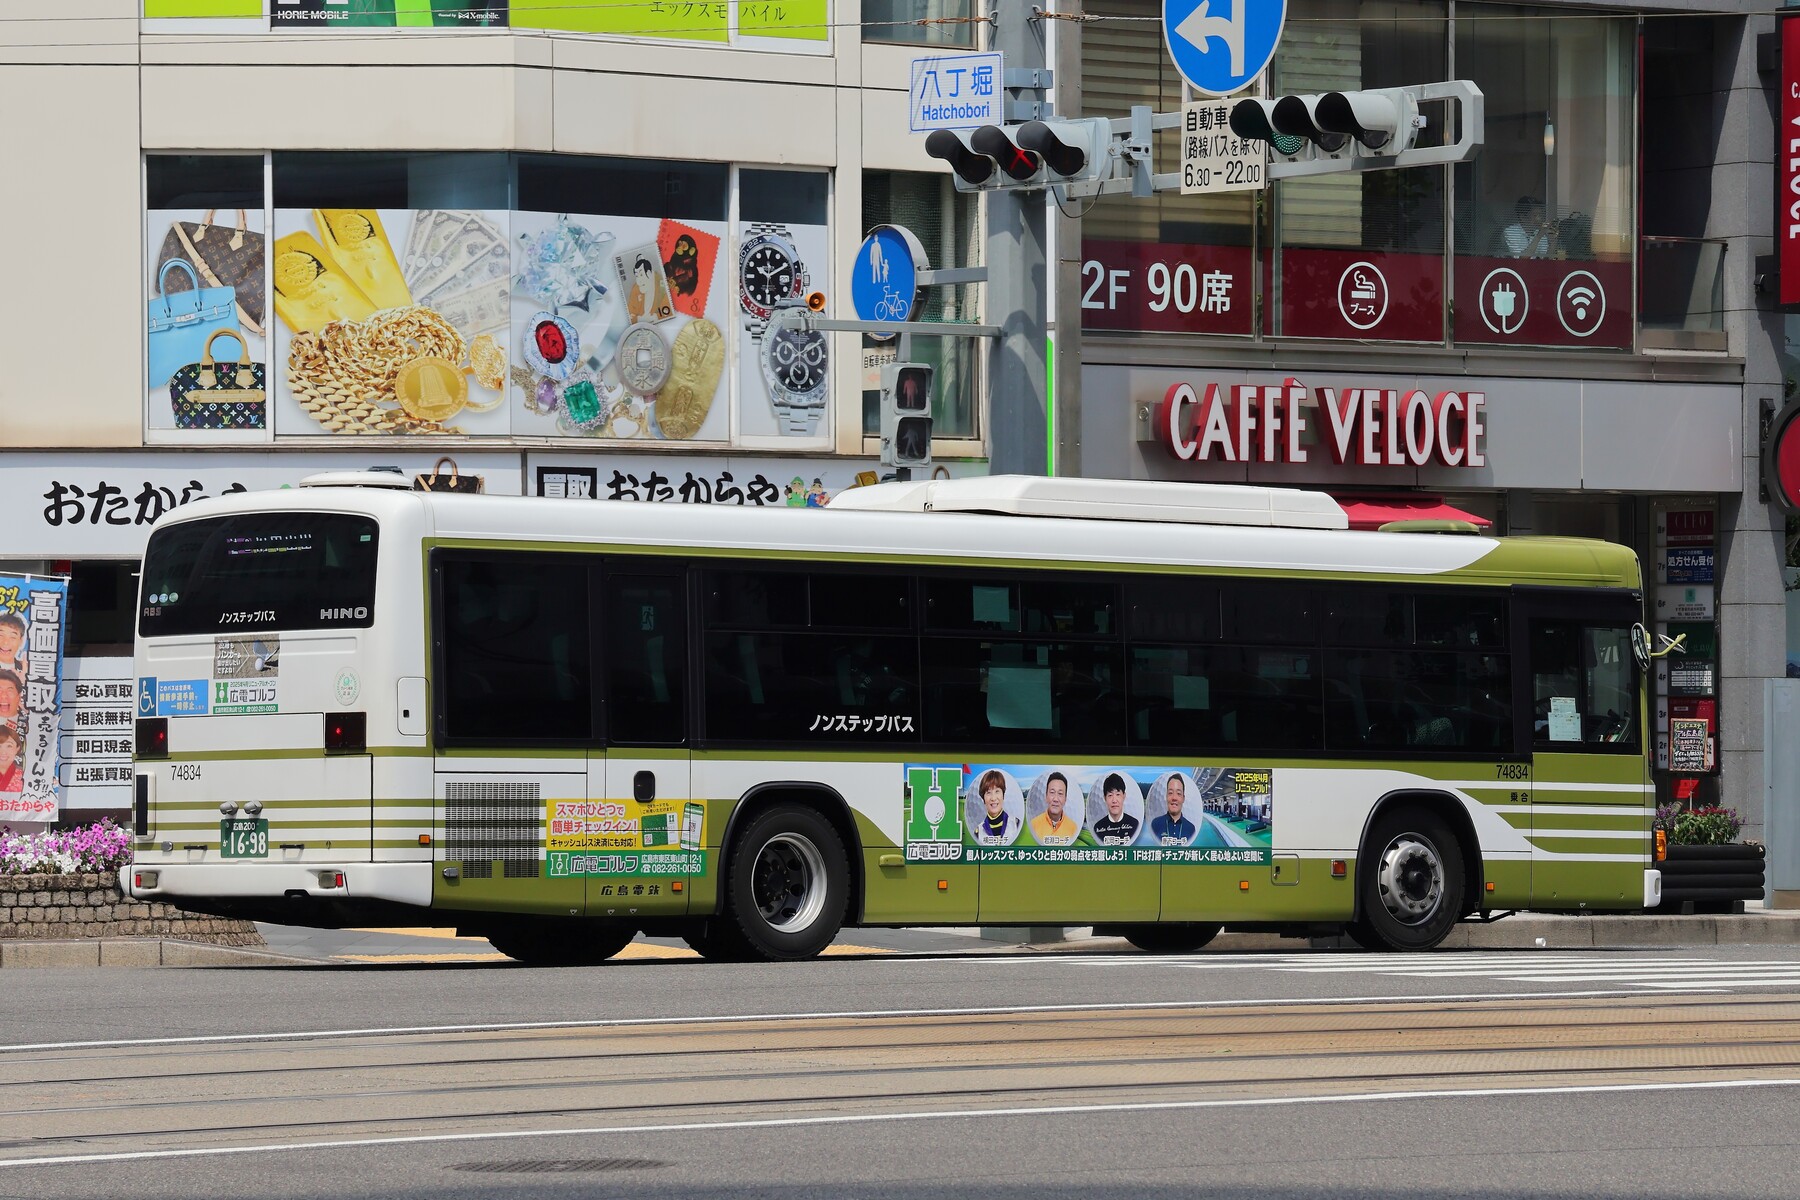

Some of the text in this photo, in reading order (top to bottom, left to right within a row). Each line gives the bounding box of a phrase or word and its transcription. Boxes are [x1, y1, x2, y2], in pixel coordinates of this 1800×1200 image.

[278, 11, 349, 20] HORIE MOBILE
[920, 66, 993, 99] 八丁堀
[922, 101, 990, 120] Hatchobori
[1186, 106, 1236, 132] 自動車
[1081, 260, 1233, 314] 2F 90席
[1350, 303, 1376, 316] ブース
[1315, 387, 1486, 467] VELOCE
[606, 470, 780, 506] おたからや
[1668, 555, 1714, 567] 処方せん受付
[143, 607, 162, 617] ABS
[219, 610, 276, 624] ノンステップバス
[320, 606, 368, 620] HINO
[26, 591, 61, 713] 高価買取
[1658, 673, 1667, 681] 4F
[75, 684, 133, 698] 安心買取
[230, 689, 276, 703] 広電ゴルフ
[75, 712, 132, 726] 相談無料
[809, 714, 915, 732] ノンステップバス
[76, 740, 132, 753] 即日現金
[76, 768, 132, 781] 出張買取
[171, 764, 201, 780] 74834
[1235, 773, 1268, 782] 2025年4月
[1496, 764, 1529, 779] 74834
[1235, 783, 1268, 794] リニューアル!
[1510, 792, 1529, 802] 乗合
[0, 800, 55, 812] おたからや
[556, 803, 625, 816] スマホひとつで
[552, 819, 638, 834] 簡単チェックイン!
[550, 838, 637, 848] キャッシュレス決済にも対応!
[906, 844, 962, 861] 広電ゴルフ
[570, 855, 638, 873] 広電ゴルフ
